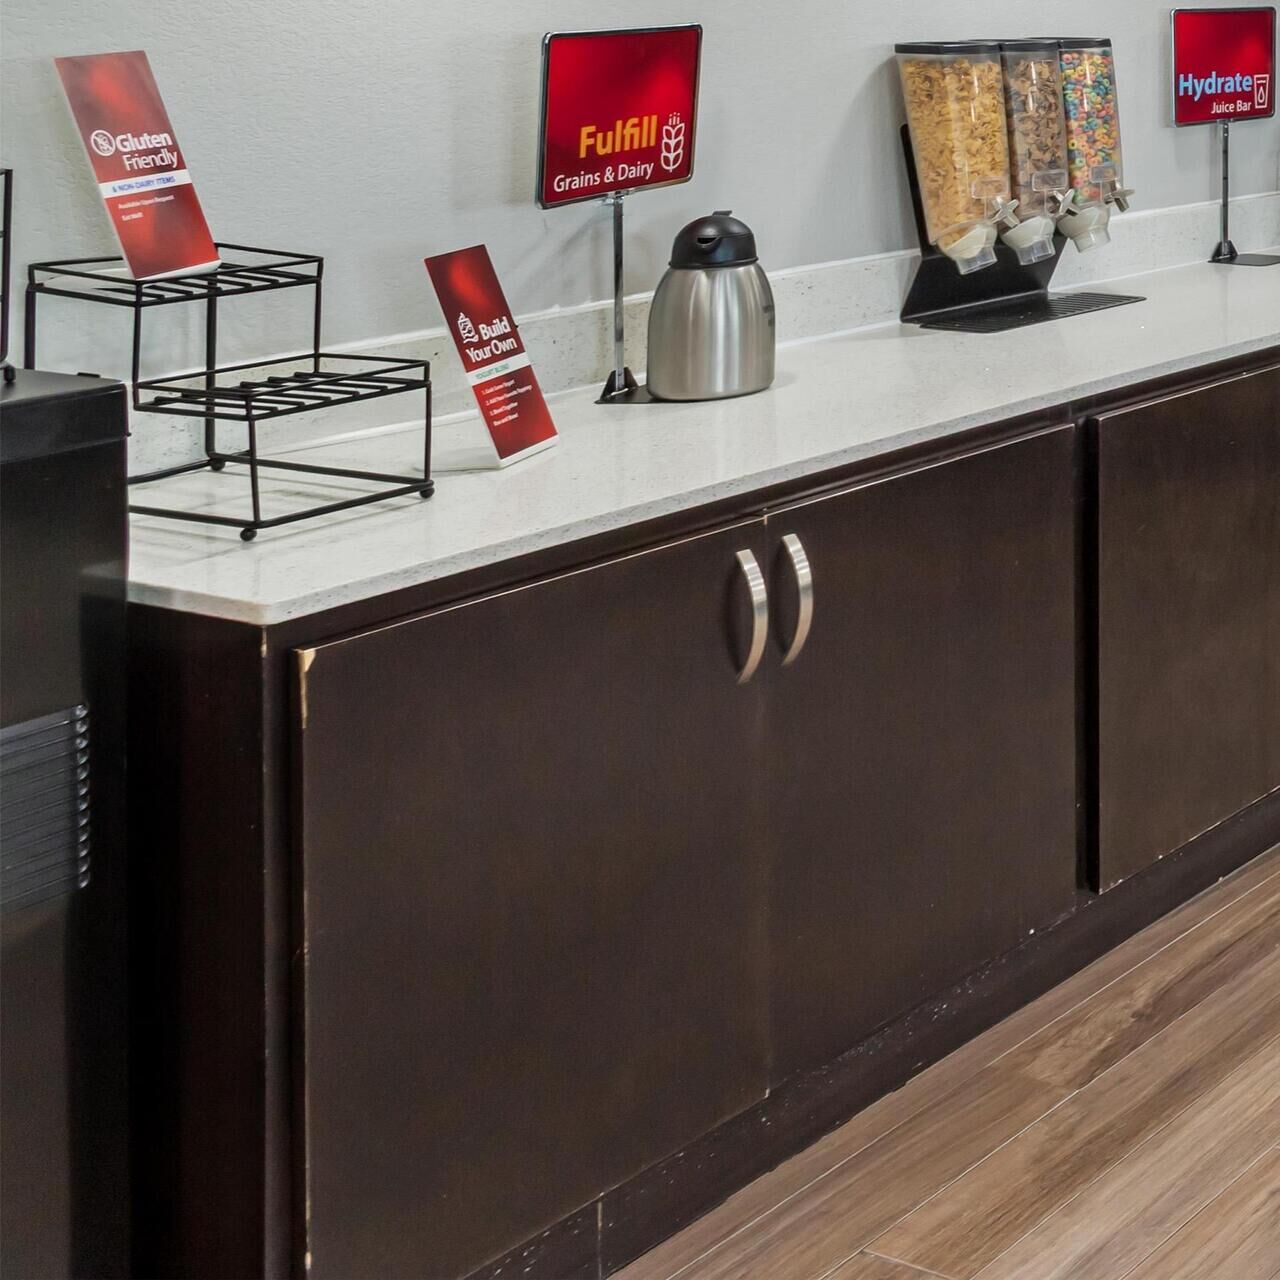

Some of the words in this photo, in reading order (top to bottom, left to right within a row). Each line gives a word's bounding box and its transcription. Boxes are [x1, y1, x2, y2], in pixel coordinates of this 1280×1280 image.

[1179, 71, 1253, 102] Hydrate
[1211, 100, 1235, 114] Juice
[1236, 100, 1252, 112] Bar
[116, 132, 173, 152] Gluten
[579, 114, 658, 159] Fulfill
[122, 148, 177, 171] Friendly
[156, 176, 176, 185] ITEMS
[553, 171, 601, 192] Grains
[603, 166, 615, 183] &
[618, 161, 654, 181] Dairy
[479, 316, 512, 340] Build
[465, 345, 492, 363] Your
[491, 338, 518, 355] Own
